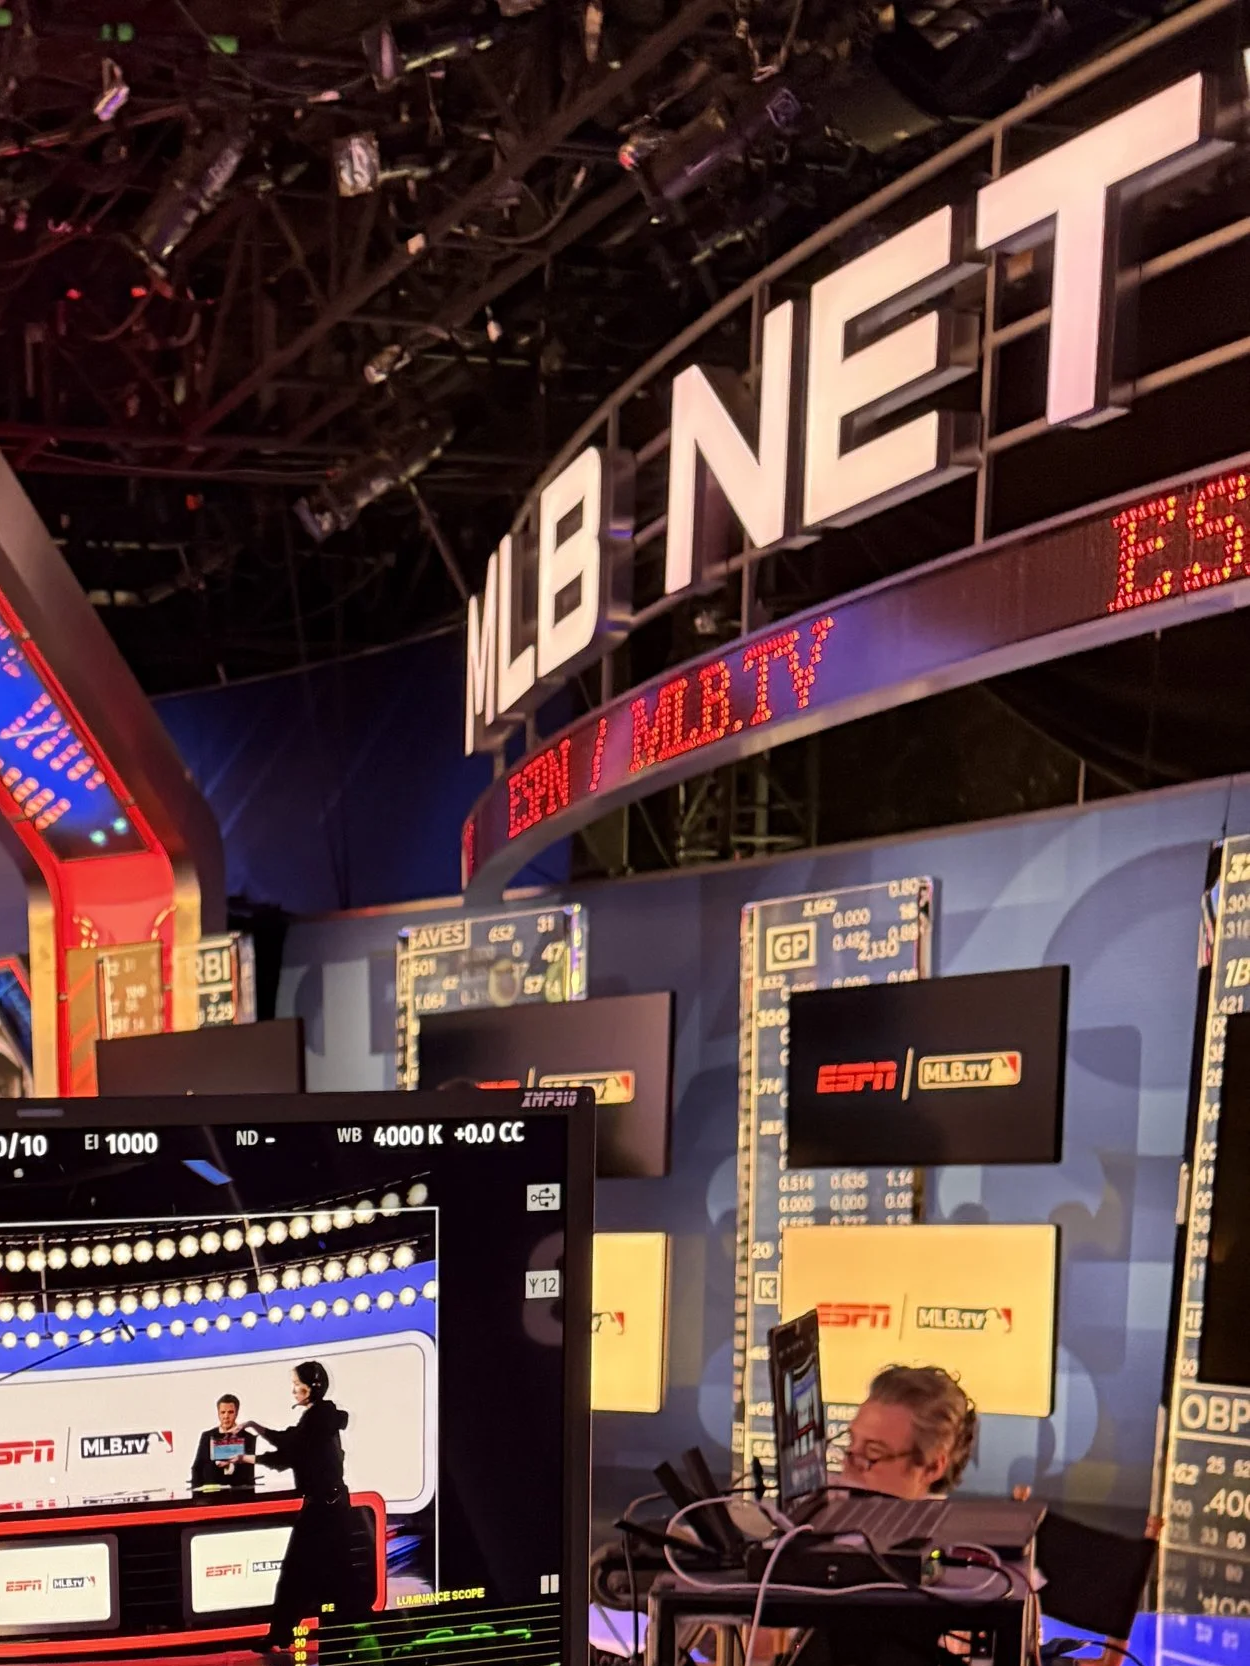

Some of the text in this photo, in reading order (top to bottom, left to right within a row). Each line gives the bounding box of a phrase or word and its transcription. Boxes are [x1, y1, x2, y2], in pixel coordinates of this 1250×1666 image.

[465, 50, 1250, 757] MLB NET
[629, 616, 836, 773] MLB.TV
[773, 933, 808, 961] GP
[816, 1060, 989, 1093] ESPN MLB.TV
[105, 1132, 159, 1155] 1000
[236, 1129, 259, 1147] ND
[337, 1121, 525, 1148] WB 4000 K +0.0 CC
[816, 1304, 986, 1328] ESPN MLB.TV
[1180, 1393, 1250, 1432] OBP
[82, 1437, 146, 1458] MLB.TV
[206, 1564, 242, 1577] ESPN
[6, 1577, 84, 1592] ESPN MLB.TV
[396, 1593, 451, 1606] LUMINANCE
[451, 1587, 485, 1600] SCOPE
[292, 1626, 309, 1637] 100
[294, 1638, 306, 1648] 90
